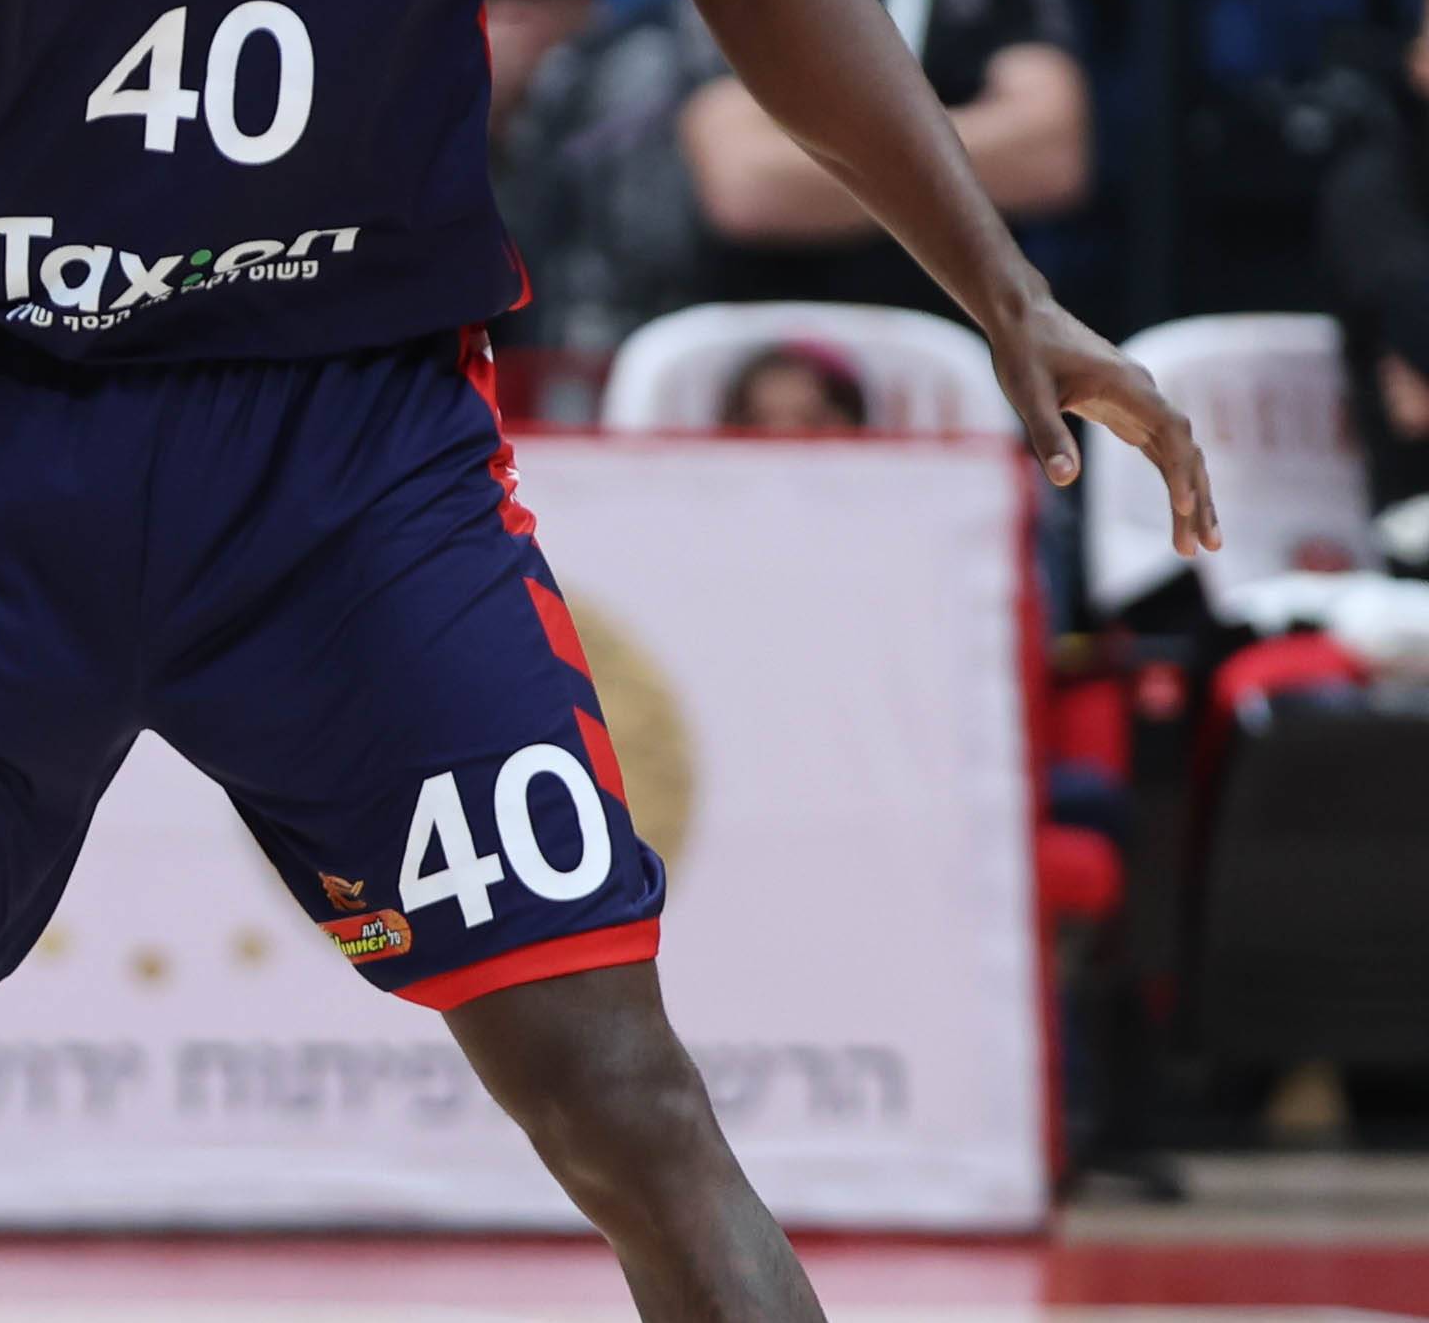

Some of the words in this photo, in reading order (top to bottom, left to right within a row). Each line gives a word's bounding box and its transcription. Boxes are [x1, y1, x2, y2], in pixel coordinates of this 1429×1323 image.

[85, 0, 315, 166] 40
[249, 260, 319, 281] פשוט
[399, 743, 612, 929] 40
